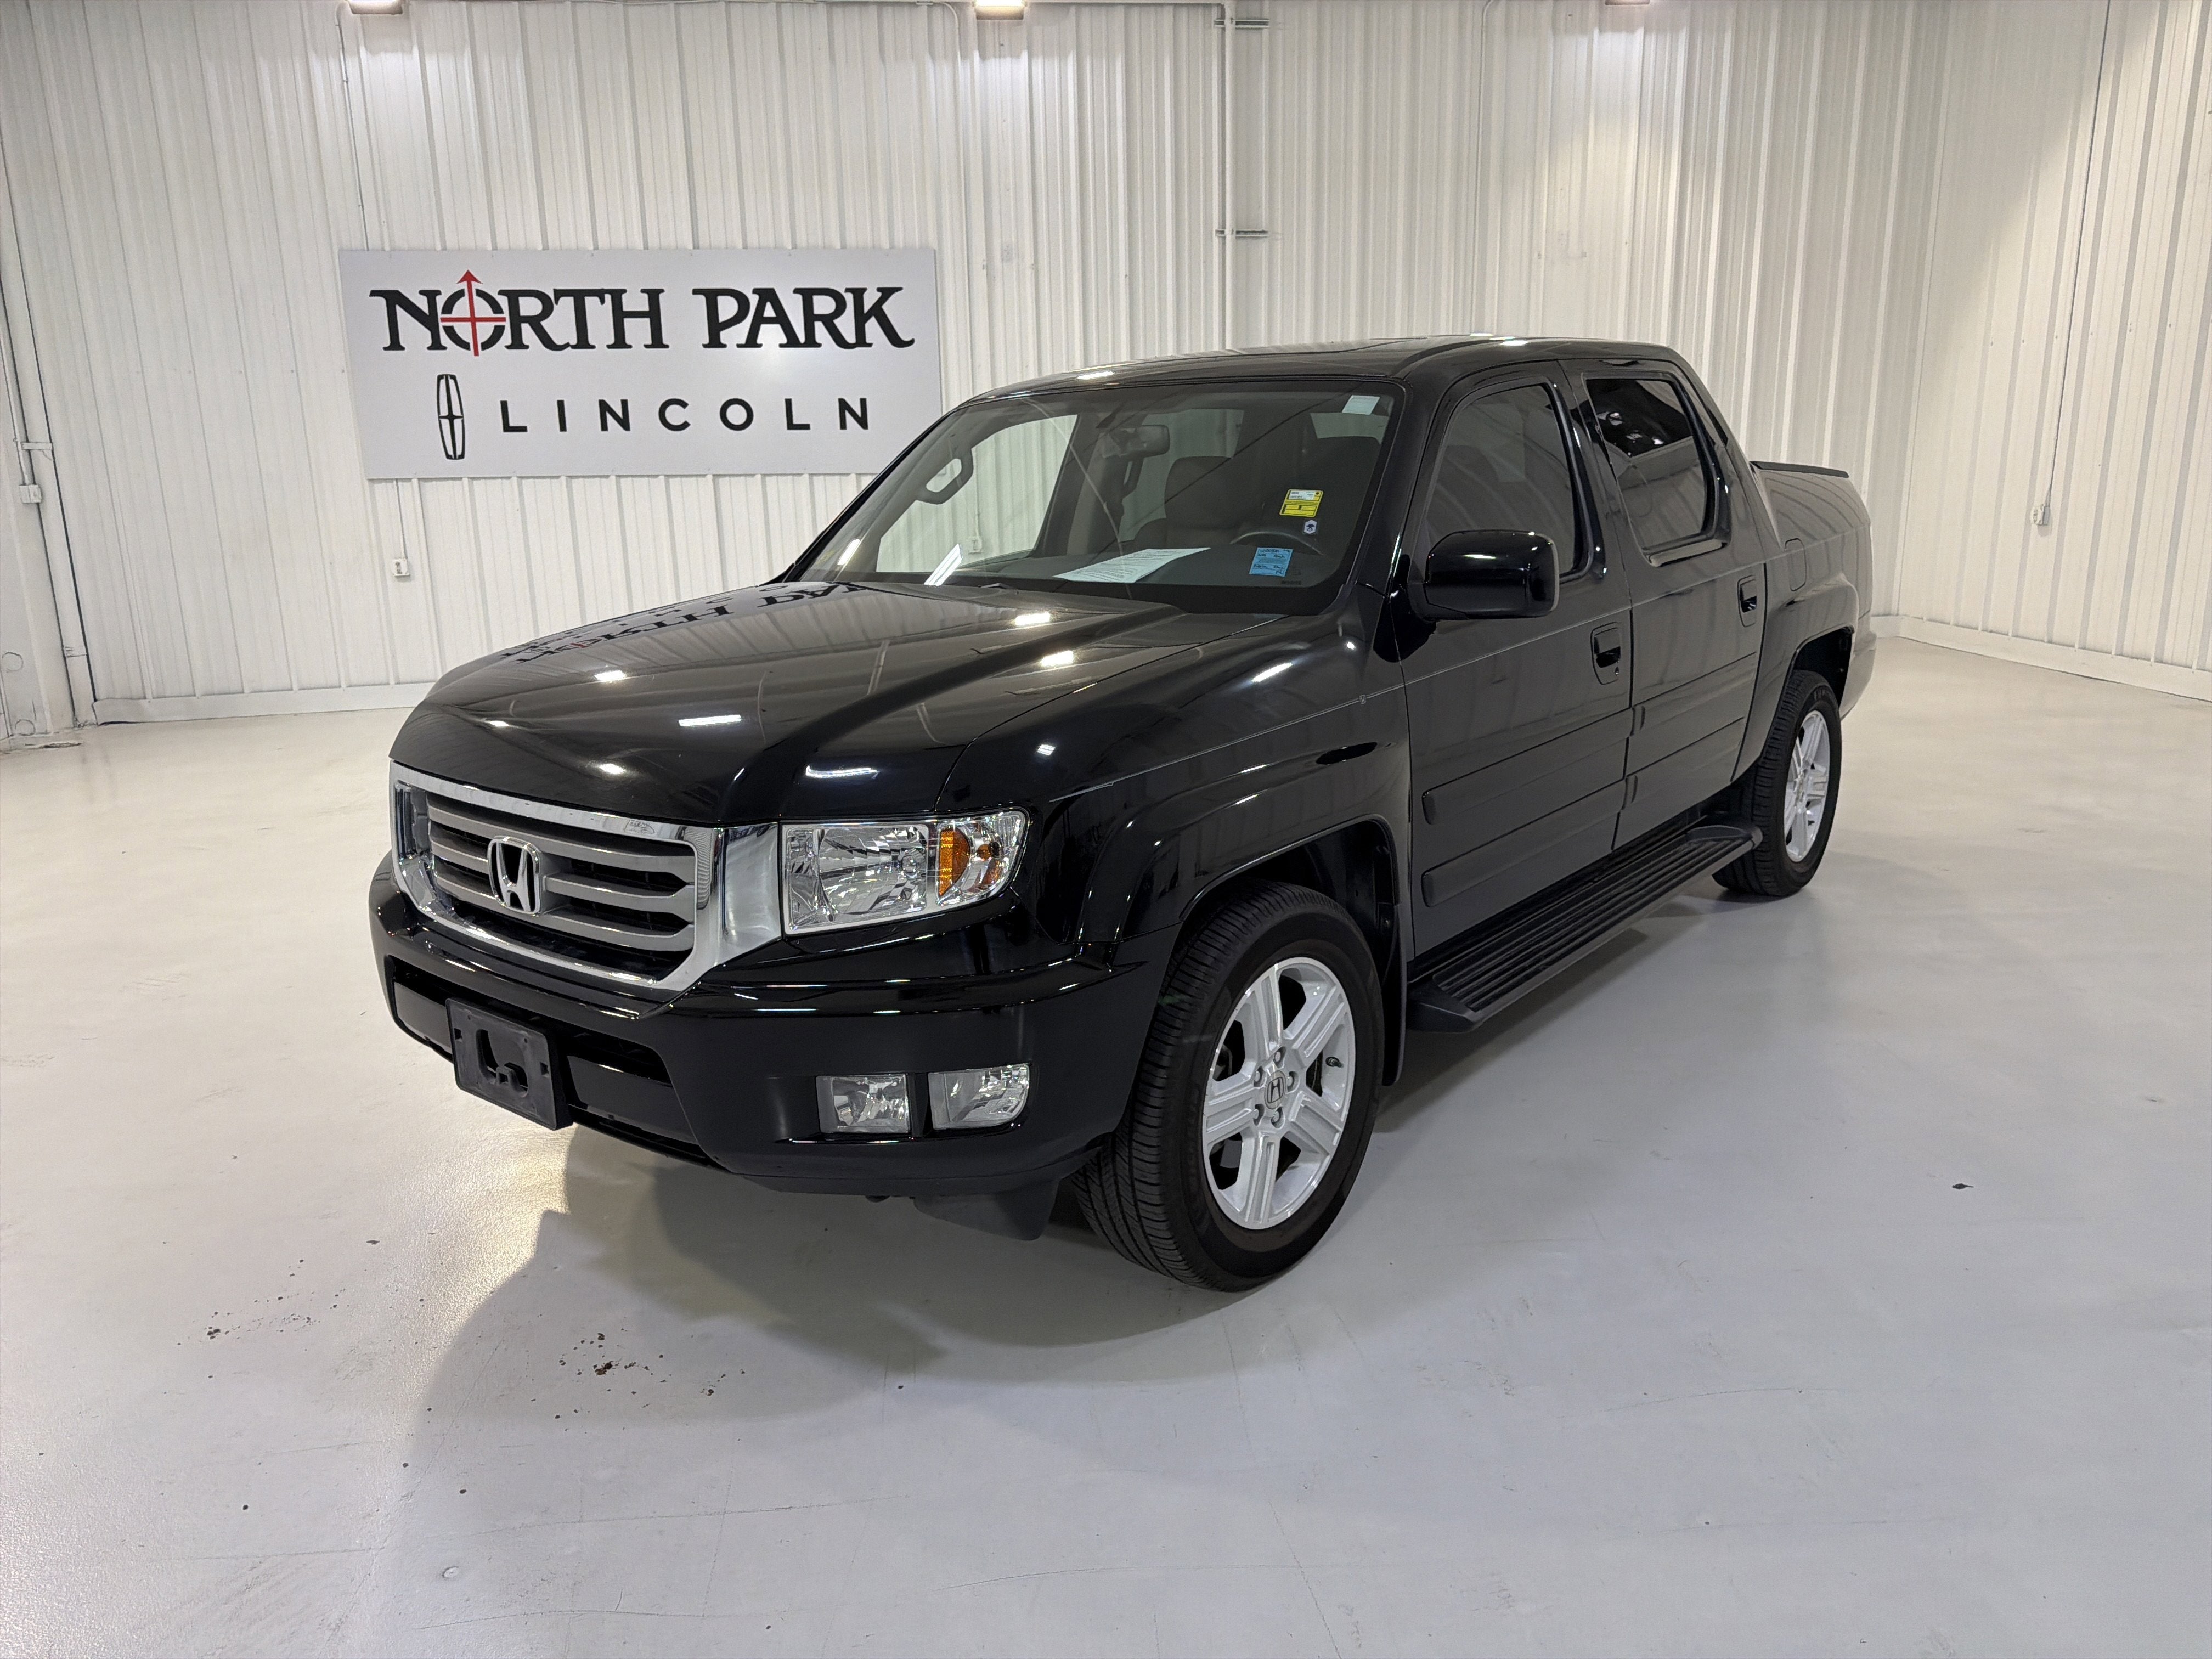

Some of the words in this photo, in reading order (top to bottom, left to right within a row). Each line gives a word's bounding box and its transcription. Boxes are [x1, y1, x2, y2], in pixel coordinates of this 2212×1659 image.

[369, 285, 670, 353] NORTH
[692, 287, 915, 349] PARK
[500, 398, 868, 433] LINCOLN
